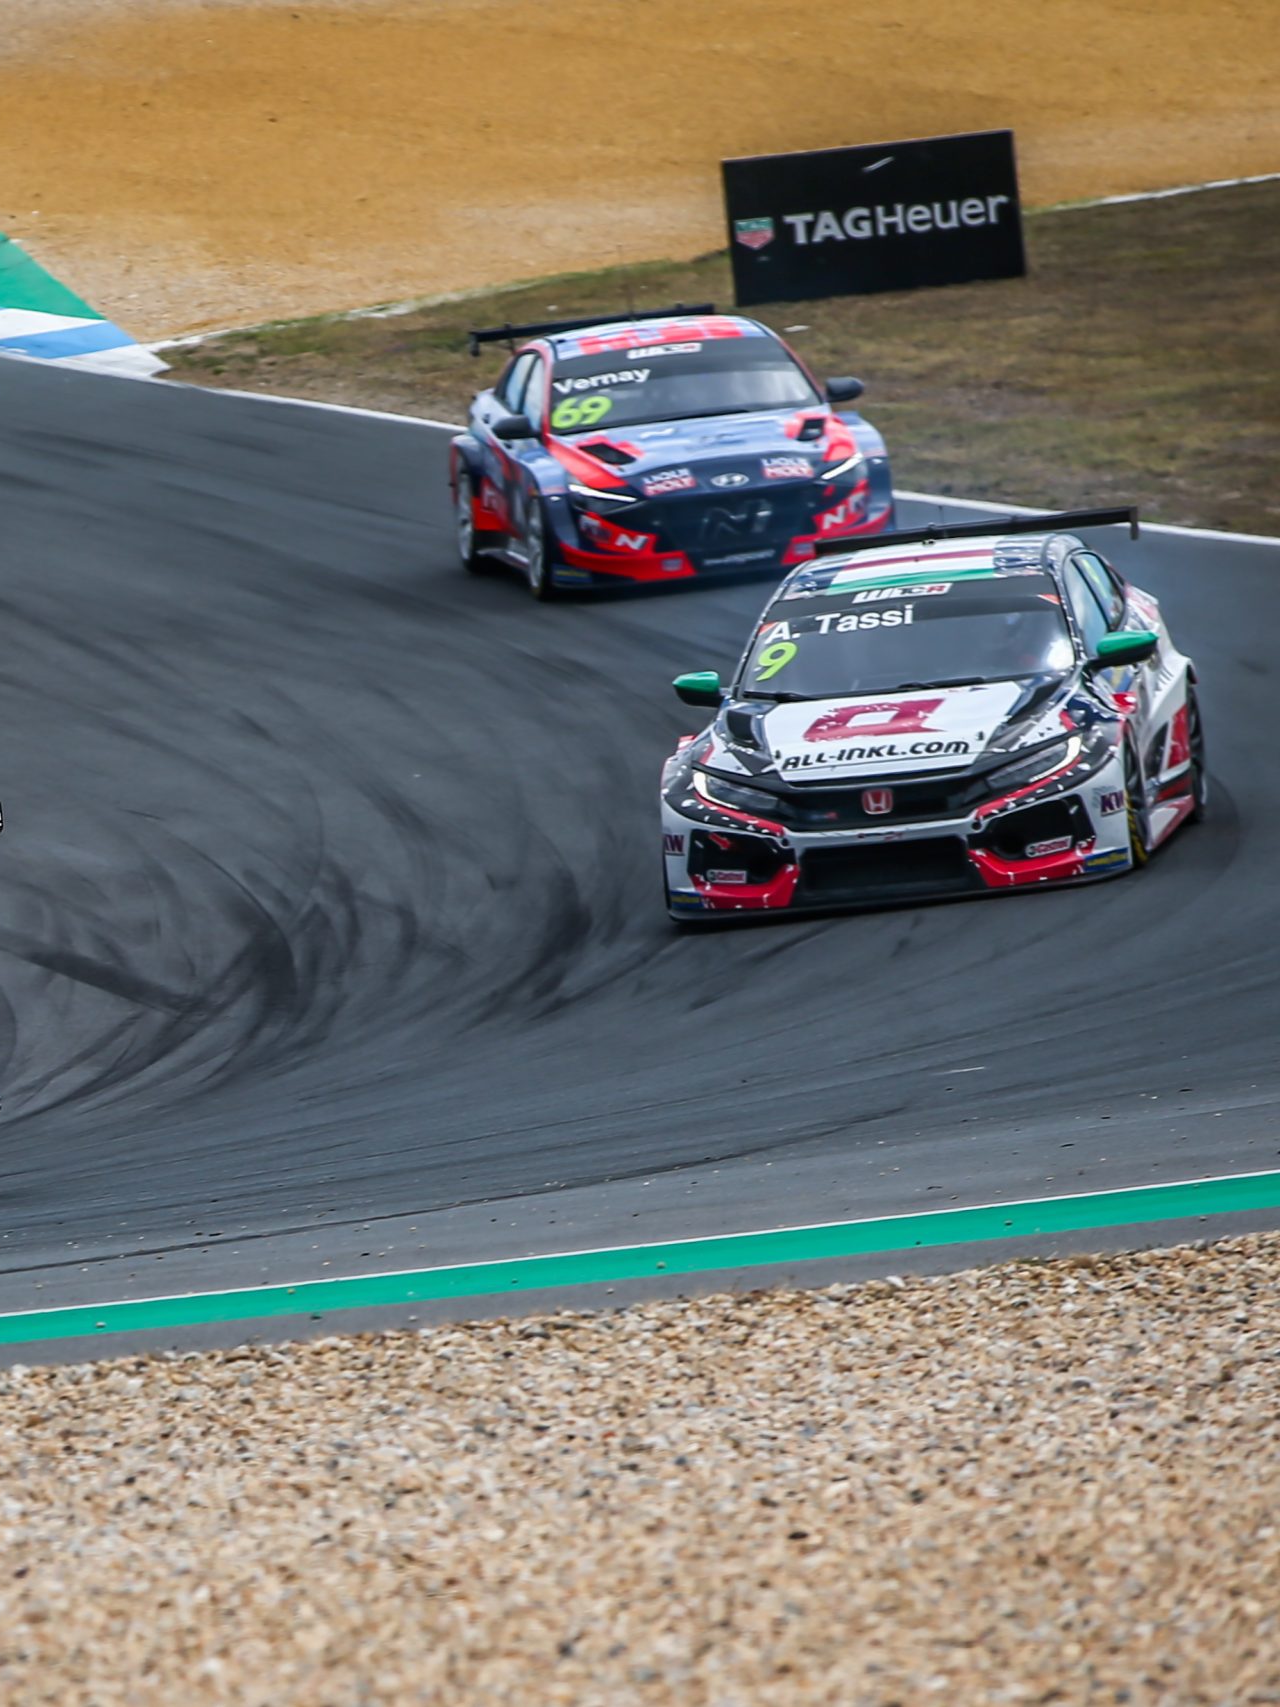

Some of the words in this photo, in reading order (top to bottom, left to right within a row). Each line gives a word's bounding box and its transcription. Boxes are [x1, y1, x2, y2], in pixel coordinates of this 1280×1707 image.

[552, 368, 651, 394] Vernay
[551, 396, 613, 429] 69
[764, 621, 802, 644] A.
[815, 604, 914, 635] Tassi
[754, 641, 798, 682] 9
